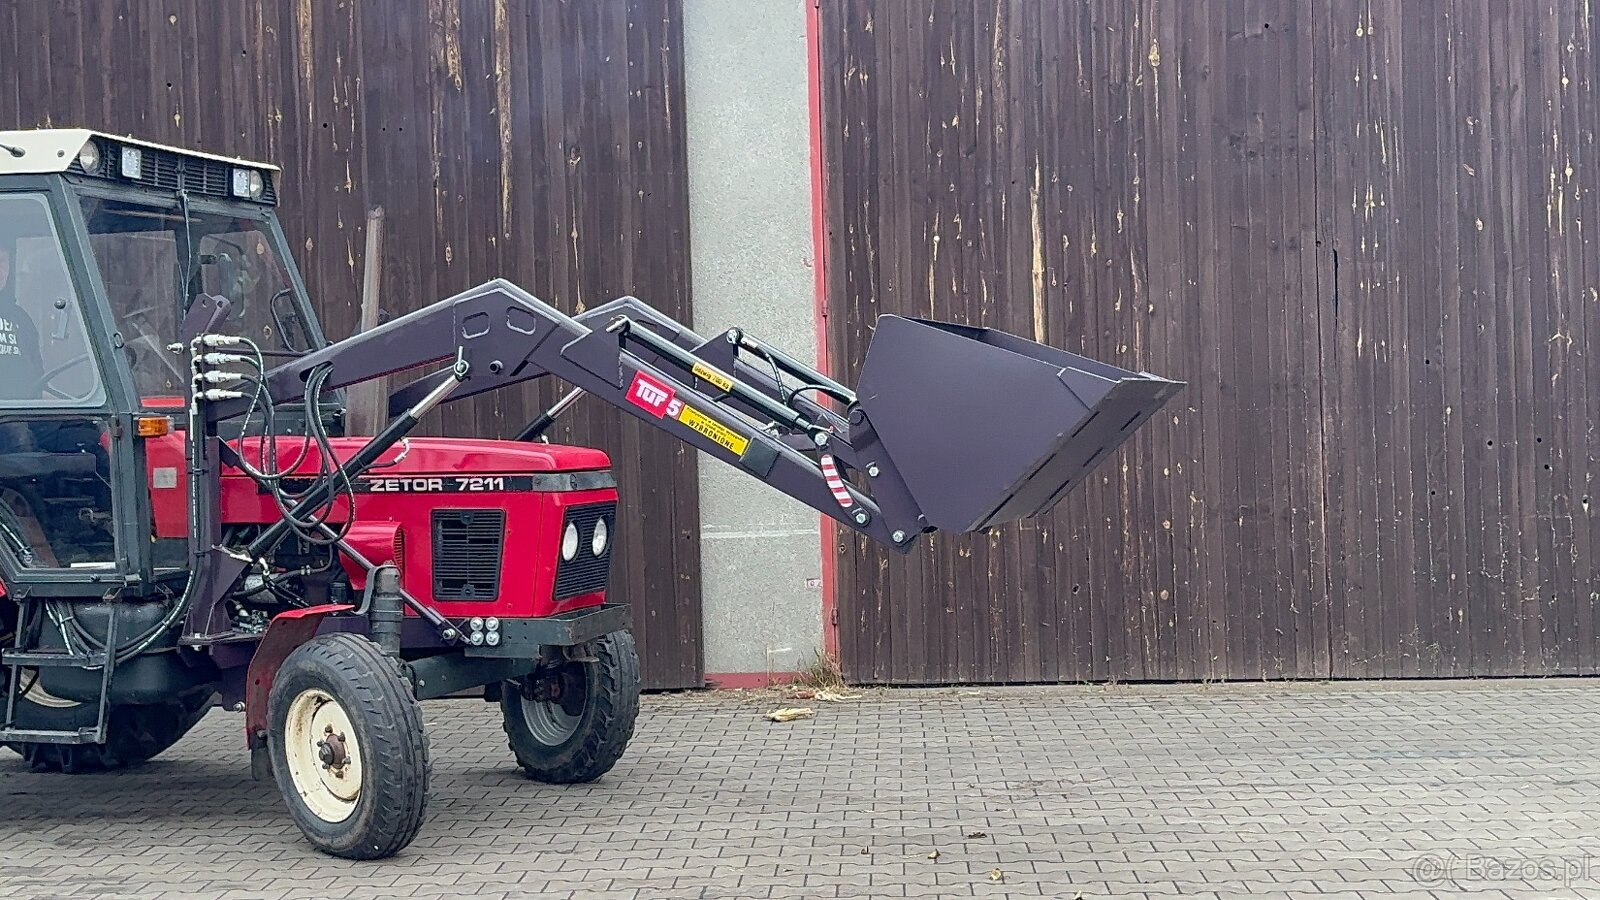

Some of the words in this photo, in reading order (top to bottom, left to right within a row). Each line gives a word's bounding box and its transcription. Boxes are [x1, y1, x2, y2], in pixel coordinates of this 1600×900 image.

[666, 399, 681, 416] 5
[370, 478, 443, 492] ZETOR
[455, 477, 504, 491] 7211
